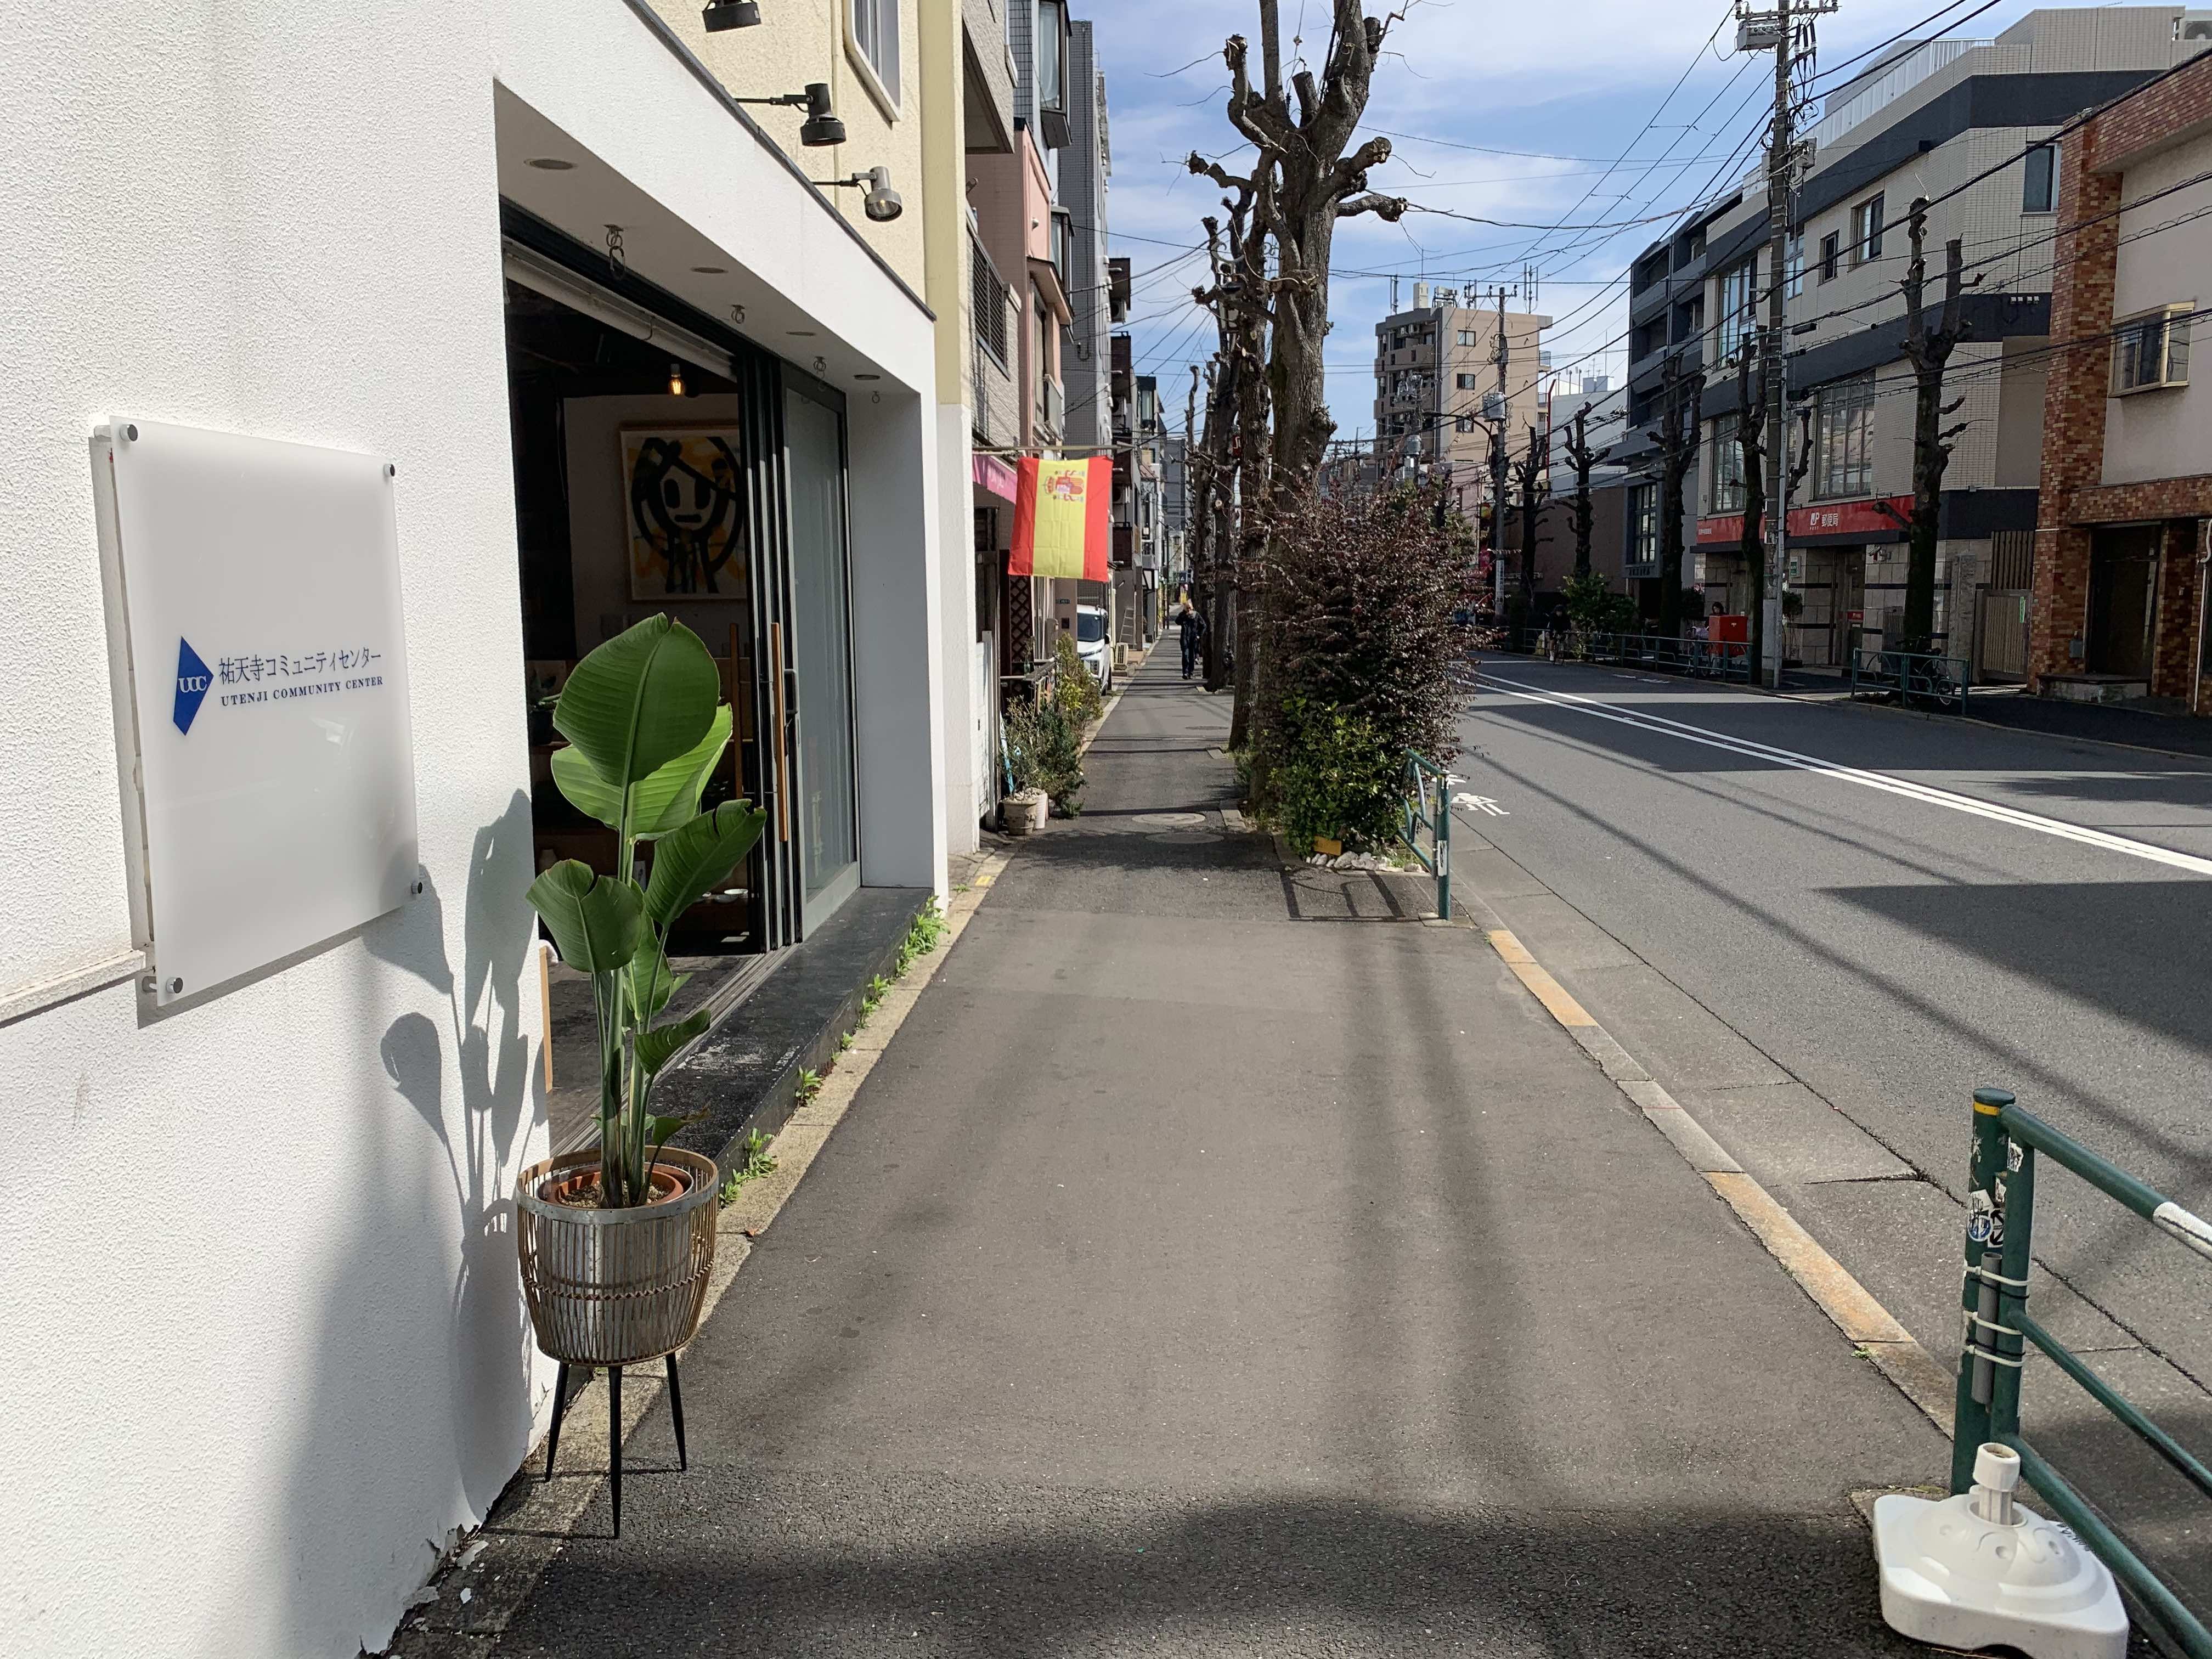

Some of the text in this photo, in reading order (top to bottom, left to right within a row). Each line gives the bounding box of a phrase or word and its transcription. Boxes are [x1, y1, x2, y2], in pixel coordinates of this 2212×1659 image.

[219, 647, 381, 685] 祐天寺コミュニティセンター
[179, 676, 207, 693] UCC
[221, 676, 383, 707] UTENJI COMMUNITY CENTER
